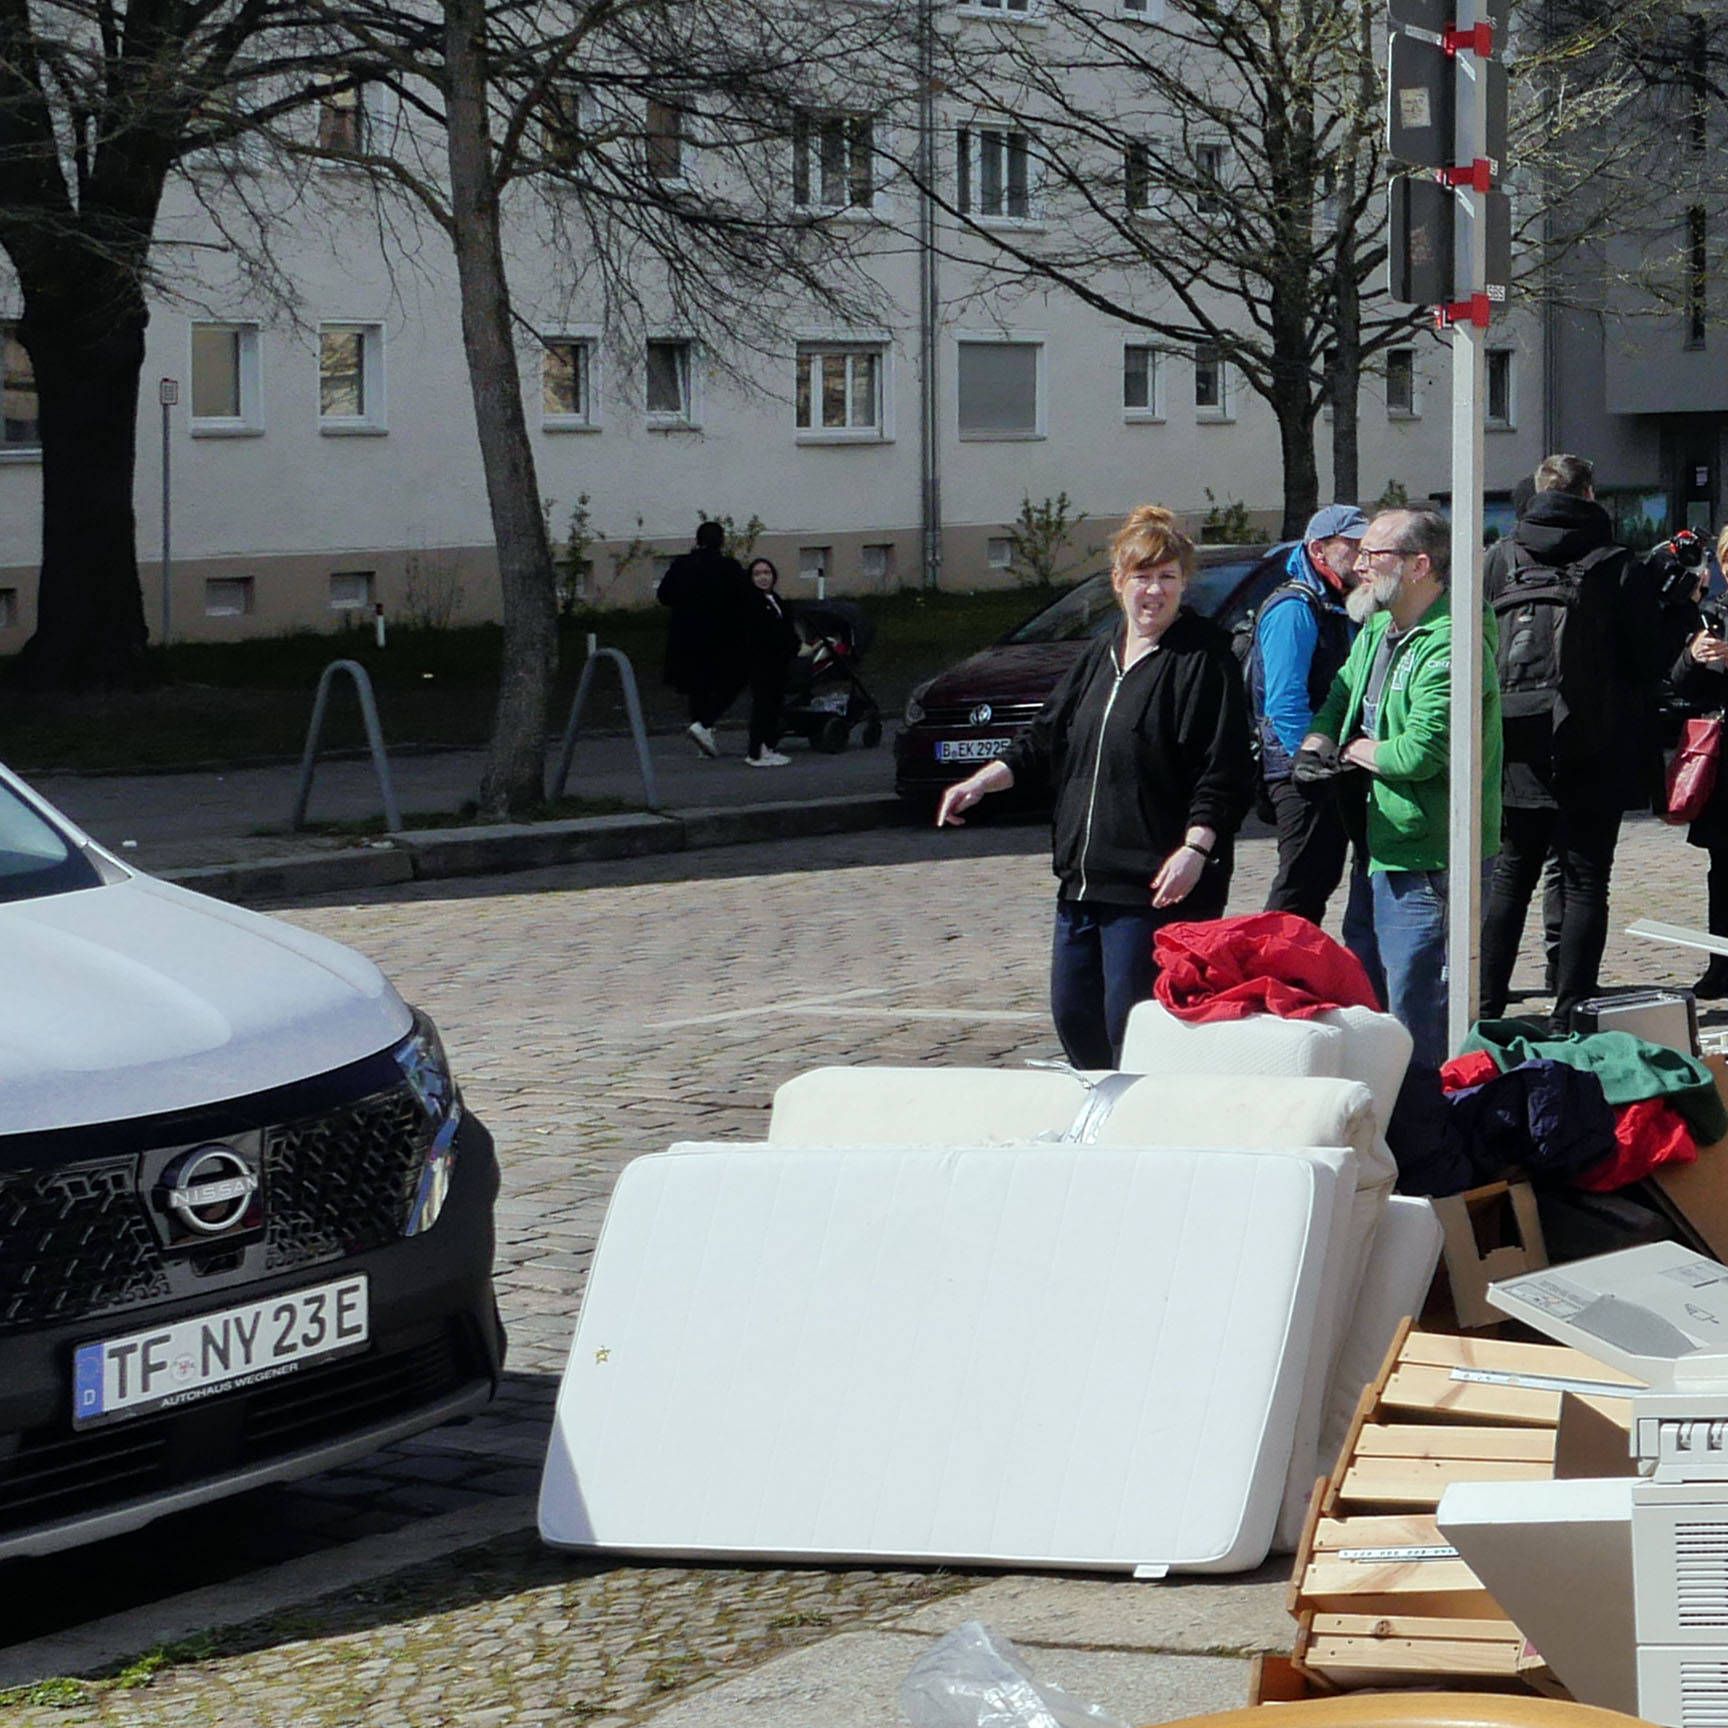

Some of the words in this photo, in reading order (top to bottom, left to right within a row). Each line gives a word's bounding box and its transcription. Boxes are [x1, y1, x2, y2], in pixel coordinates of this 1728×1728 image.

[943, 743, 951, 757] B
[958, 742, 974, 756] EK
[171, 1172, 259, 1205] NISSAN
[83, 1389, 96, 1406] D
[107, 1334, 171, 1399] TF
[201, 1311, 261, 1377] NY
[272, 1284, 363, 1357] 23E
[161, 1383, 232, 1408] AUTOHAUS
[235, 1363, 299, 1392] WEGENER
